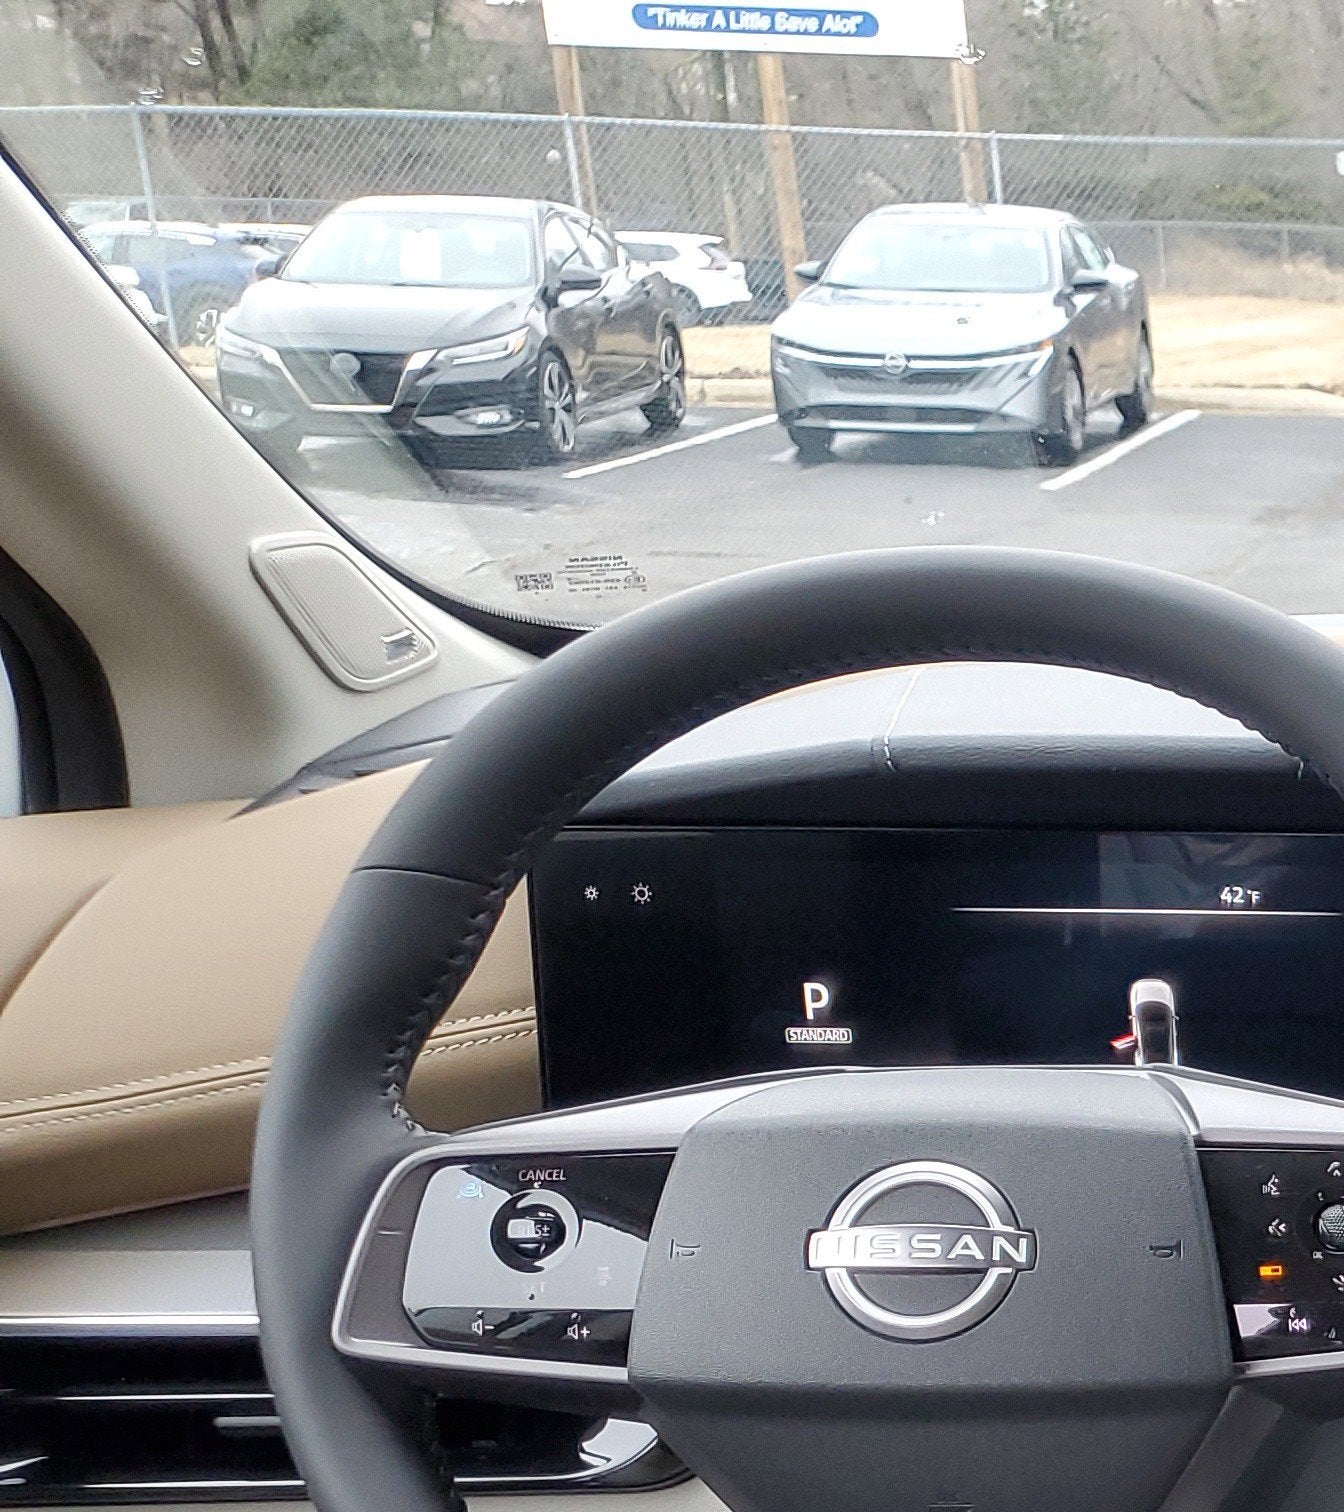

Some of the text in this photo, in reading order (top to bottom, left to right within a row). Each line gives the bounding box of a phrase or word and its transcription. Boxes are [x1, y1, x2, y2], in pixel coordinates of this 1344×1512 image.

[712, 10, 727, 30] A
[803, 982, 830, 1020] P
[788, 1028, 849, 1043] STANDARD
[518, 1169, 567, 1182] CANCEL
[815, 1234, 1027, 1263] NISSAN
